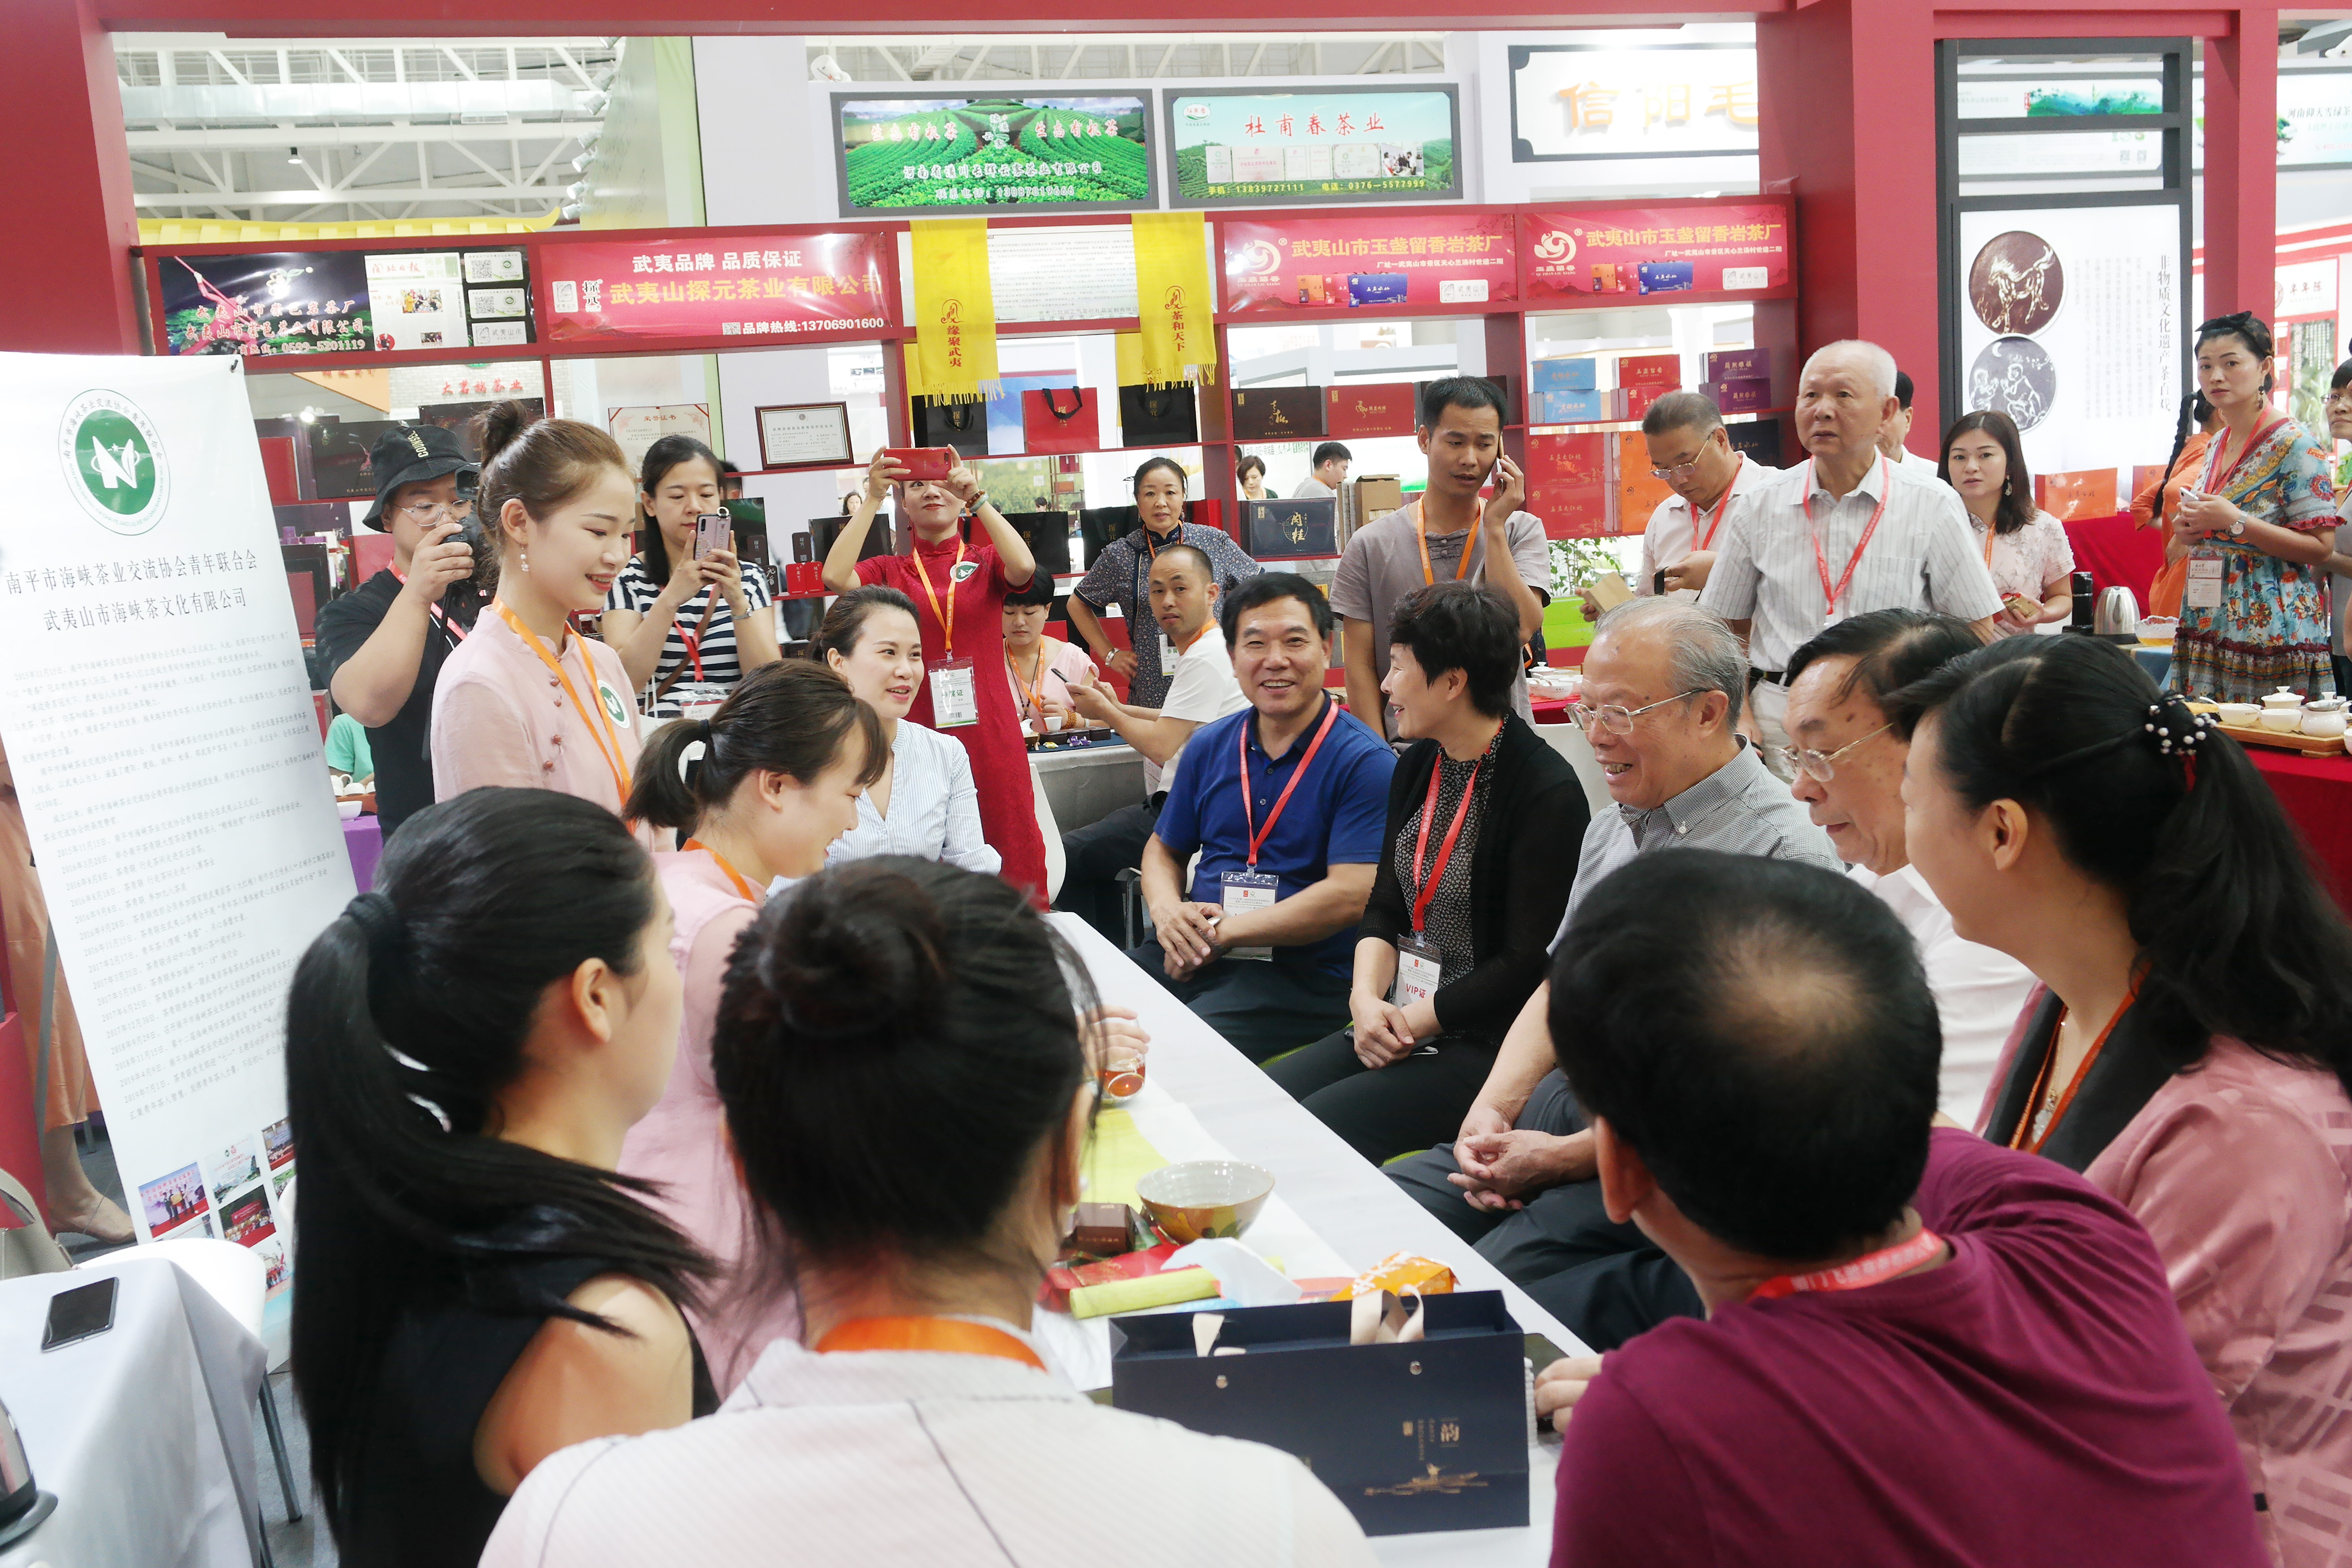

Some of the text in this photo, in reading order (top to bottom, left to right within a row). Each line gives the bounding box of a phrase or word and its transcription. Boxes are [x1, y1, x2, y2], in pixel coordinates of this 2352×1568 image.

[871, 123, 957, 141] 生态有机茶
[1035, 119, 1118, 138] 生态有机茶
[1245, 112, 1385, 137] 杜甫春茶业
[1292, 235, 1502, 258] 武夷山市玉盏留香岩茶厂
[1586, 224, 1781, 247] 武夷山市玉盏留香岩茶厂
[632, 250, 802, 274] 武夷品牌 品质保证
[609, 274, 883, 305] 武夷山探元茶业有限公司
[1171, 311, 1185, 352] 茶和天下
[947, 325, 962, 368] 缘聚武夷
[5, 549, 257, 594] 南平市海峡茶业交流协会青年联合会
[44, 587, 246, 631] 武夷山市海峡茶文化有限公司
[1406, 983, 1426, 998] VIP证
